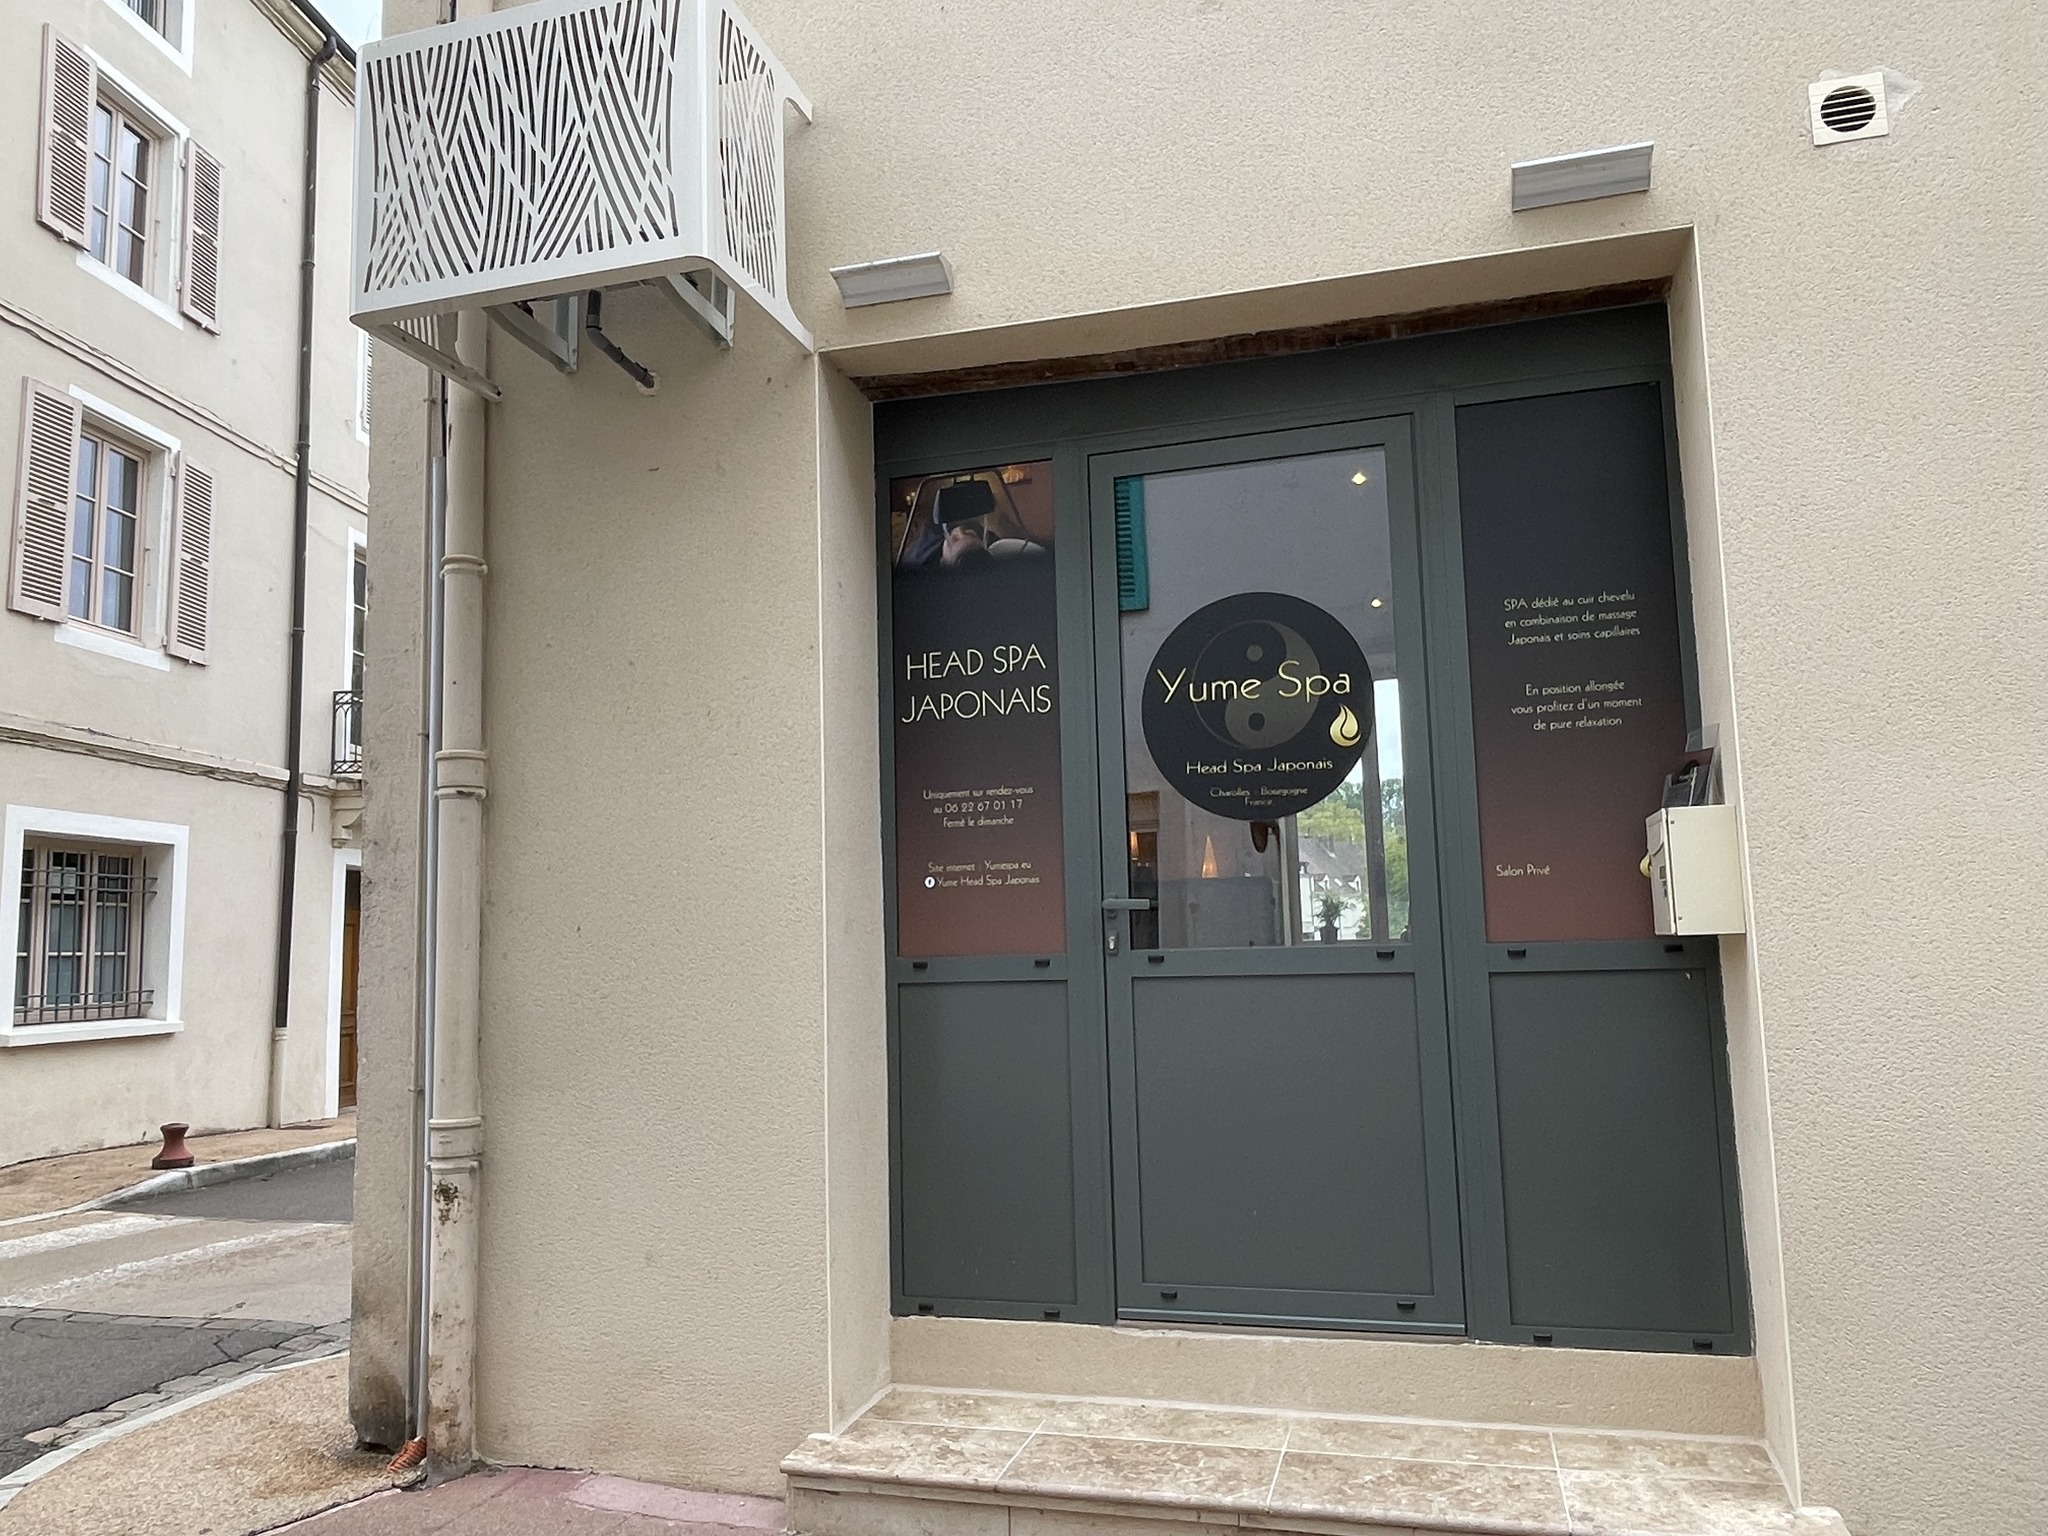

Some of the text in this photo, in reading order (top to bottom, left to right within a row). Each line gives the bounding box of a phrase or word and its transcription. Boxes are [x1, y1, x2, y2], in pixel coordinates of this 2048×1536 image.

[1504, 589, 1635, 611] SPA dédié au cuir chevelu
[1505, 610, 1637, 628] en combinaison de massage
[1508, 625, 1640, 646] Japonais et soins capillaires
[906, 643, 1046, 680] HEAD SPA
[1157, 660, 1351, 703] Yume Spa
[1525, 680, 1625, 696] En position allongée
[901, 684, 1051, 723] JAPONAIS
[1511, 698, 1642, 715] vous profitez d'un moment
[1533, 716, 1623, 731] de pure relaxation
[1186, 758, 1333, 775] Head Spa Japonais
[923, 789, 970, 800] Uniquement
[986, 785, 1034, 796] rendez-vous
[1260, 786, 1308, 796] Bourgogne
[945, 803, 958, 813] 06
[961, 802, 974, 813] 22
[977, 801, 990, 812] 67
[993, 800, 1005, 810] 01
[1011, 799, 1023, 809] 17
[943, 814, 1015, 828] Fermé le dimanche
[928, 862, 943, 873] Site
[1496, 863, 1550, 876] Salon Privé
[937, 874, 1040, 887] Yume Head Spa Japonais
